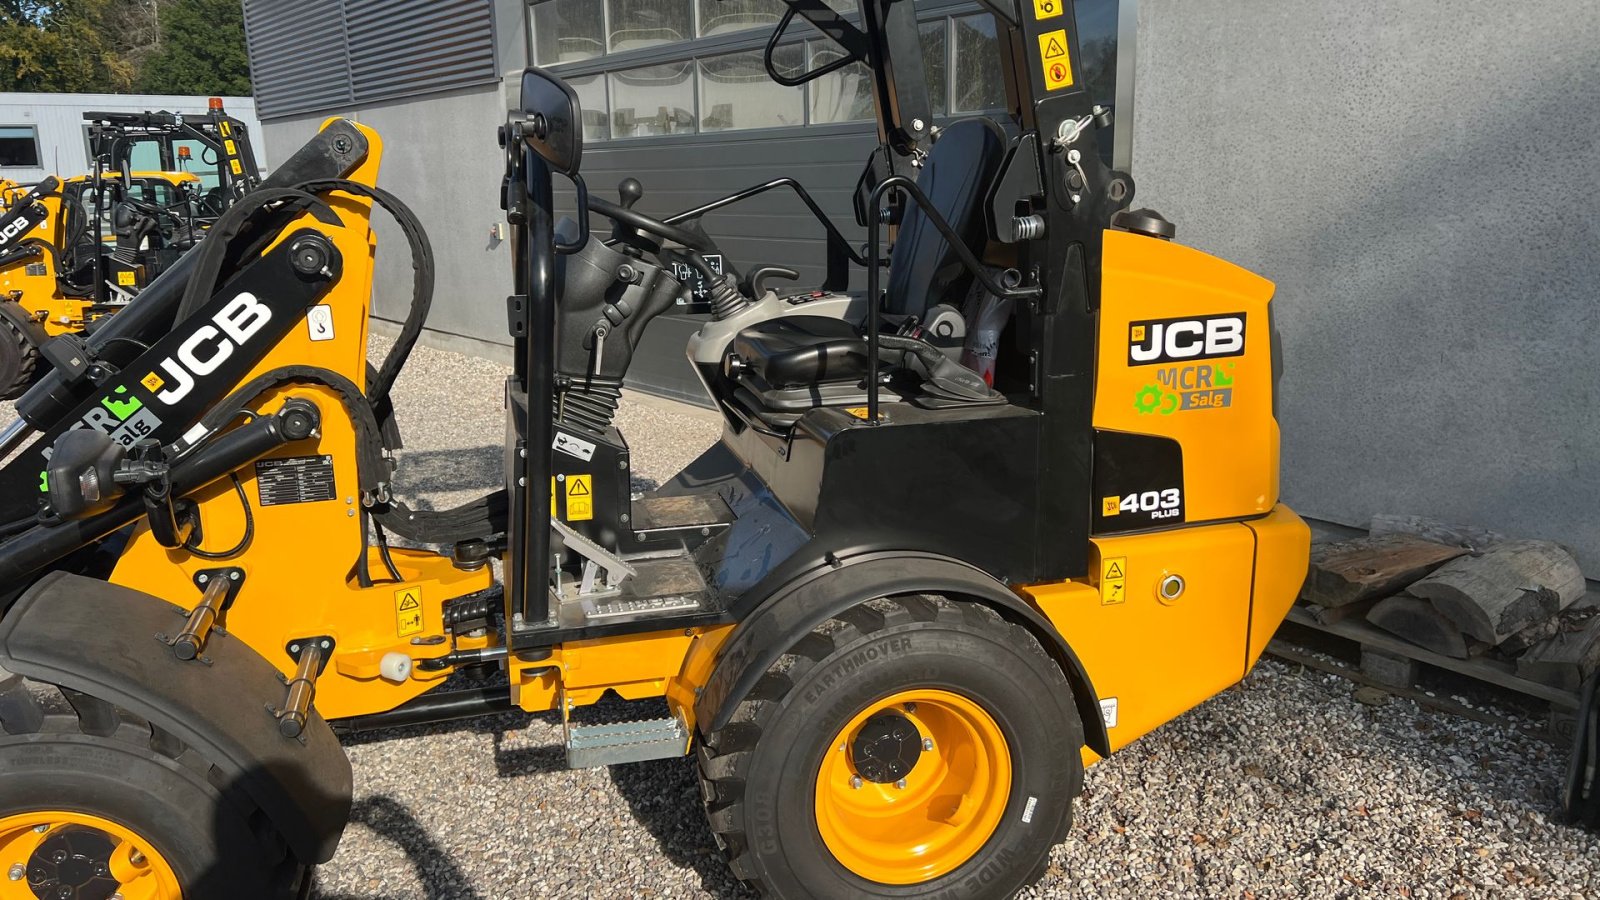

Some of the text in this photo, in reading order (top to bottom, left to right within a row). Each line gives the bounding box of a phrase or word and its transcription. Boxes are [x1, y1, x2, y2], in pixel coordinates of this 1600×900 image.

[157, 292, 272, 405] JCB
[1131, 317, 1243, 362] JCB
[1157, 365, 1213, 390] MCR
[1190, 391, 1224, 408] Salg
[112, 419, 152, 446] alg
[1120, 488, 1180, 513] 403
[1151, 508, 1180, 519] PLUS
[804, 638, 912, 704] EARTHMOVER
[965, 848, 1015, 894] WIDE
